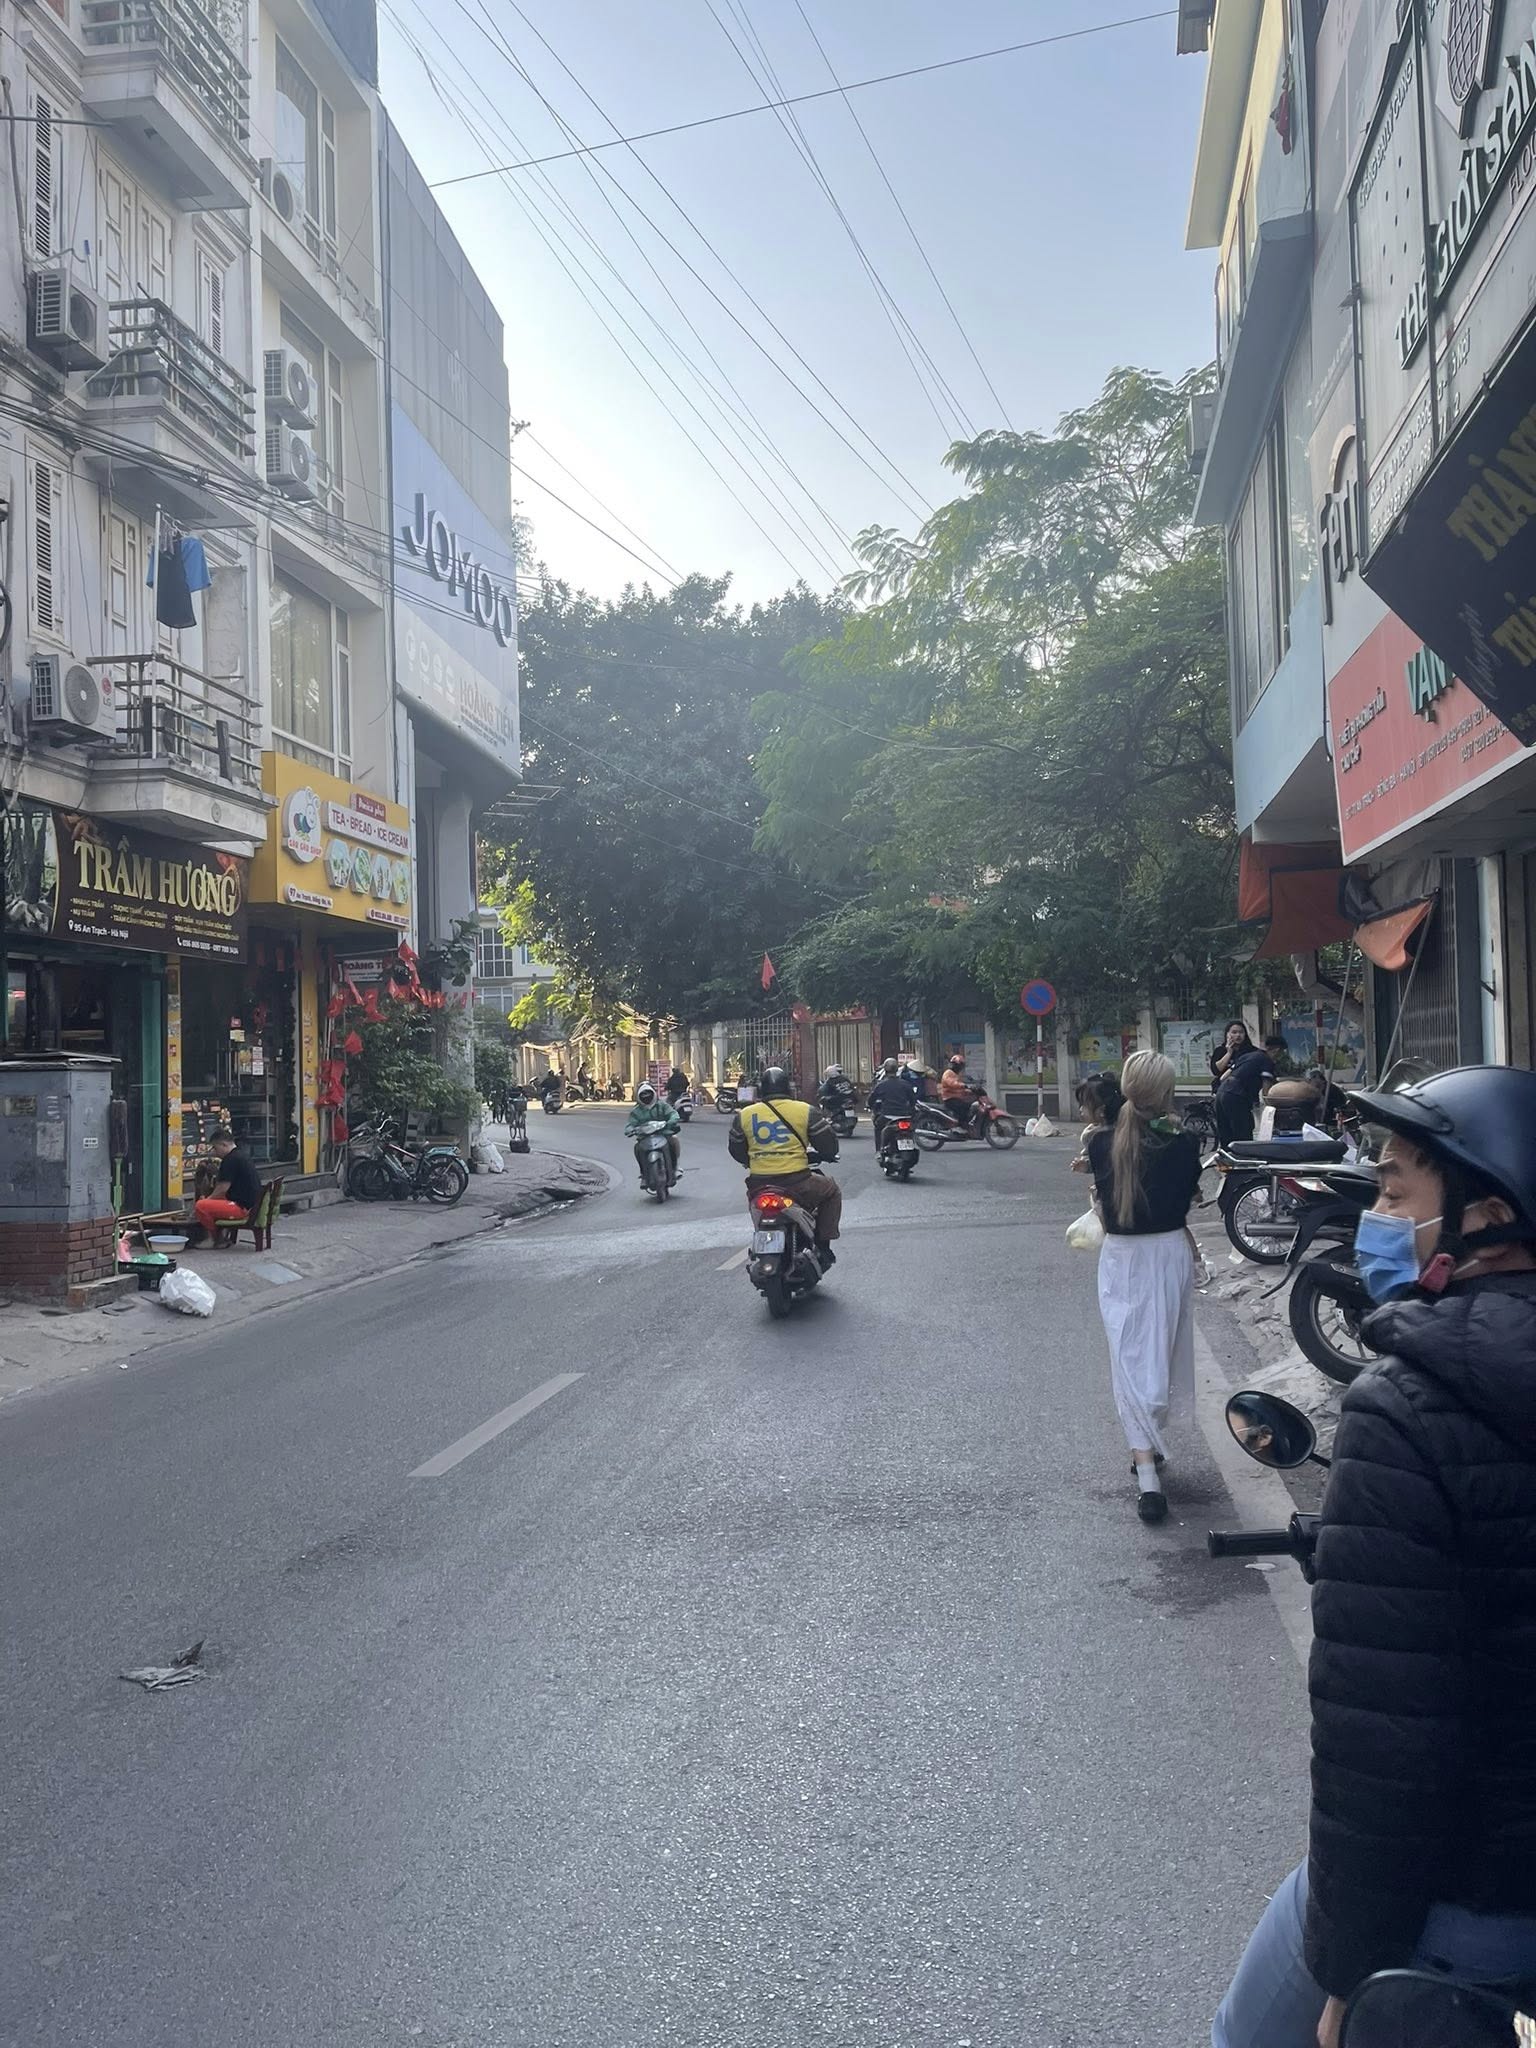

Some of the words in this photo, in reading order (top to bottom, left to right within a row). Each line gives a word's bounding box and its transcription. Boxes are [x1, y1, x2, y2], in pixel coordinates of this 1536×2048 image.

[401, 492, 515, 648] JOMOO
[460, 676, 495, 727] HOÀNG
[495, 703, 515, 743] TIẾN
[332, 809, 346, 826] TEA
[350, 817, 373, 836] BREAD
[377, 827, 388, 842] ICE
[388, 833, 409, 849] CREAM
[158, 859, 237, 917] HƯƠNG
[73, 923, 82, 932] 95
[82, 925, 91, 934] An
[91, 926, 107, 937] Trạch
[752, 1113, 793, 1145] be
